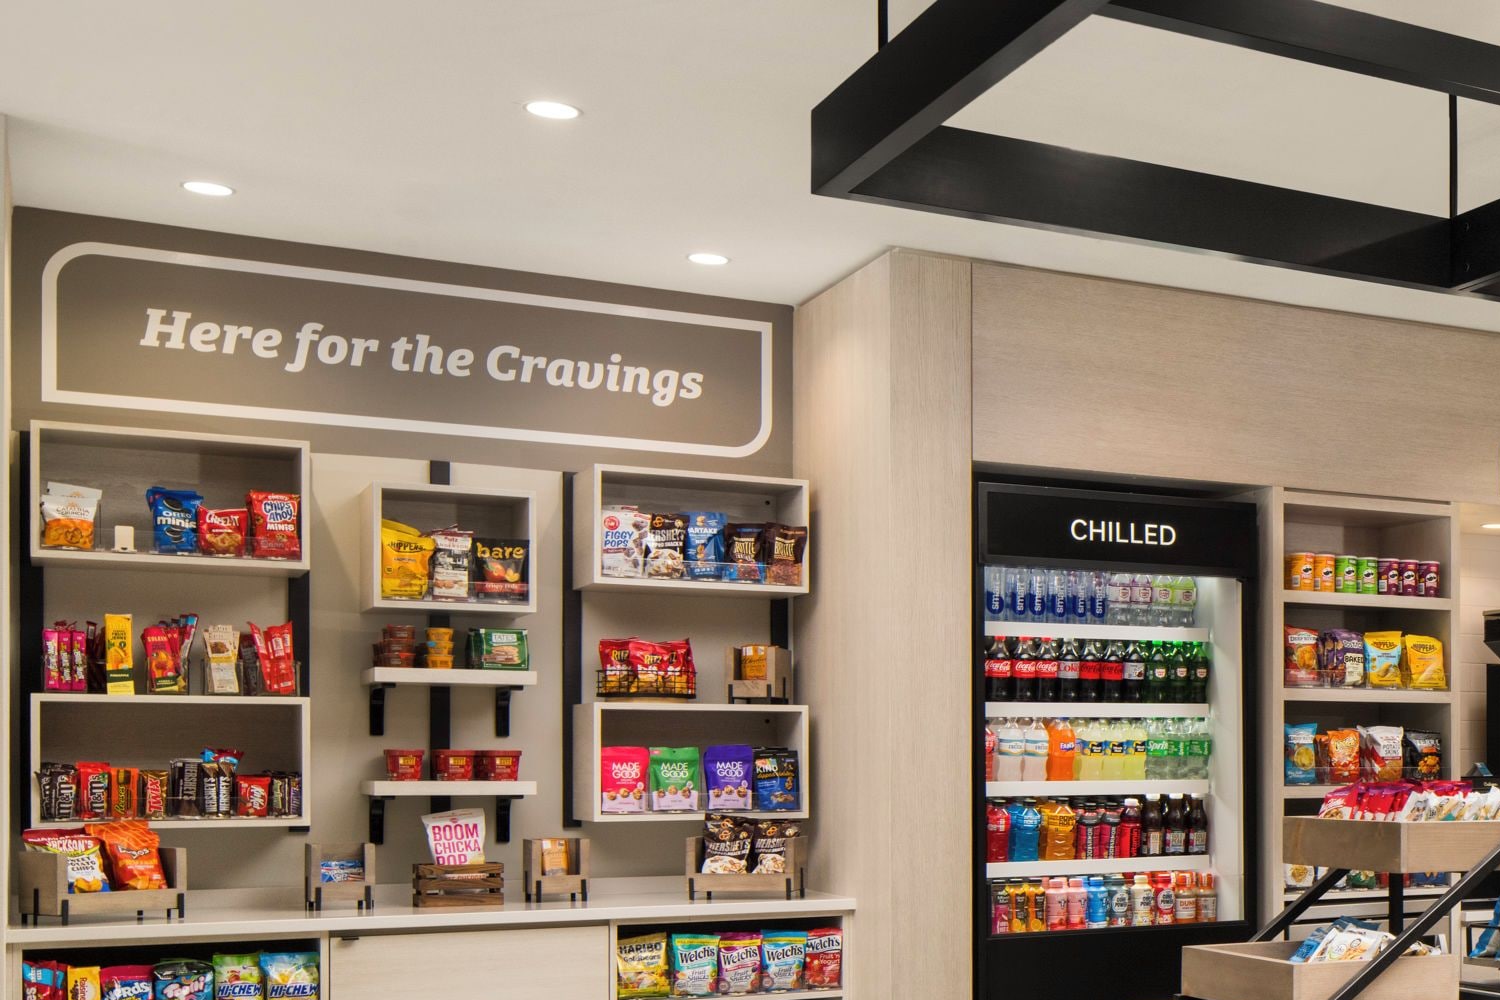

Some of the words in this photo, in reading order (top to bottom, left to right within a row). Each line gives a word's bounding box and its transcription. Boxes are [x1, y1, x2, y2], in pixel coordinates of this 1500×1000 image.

[141, 308, 282, 360] Here
[285, 322, 379, 373] for
[391, 333, 473, 379] the
[487, 343, 704, 408] Cravings
[157, 516, 197, 528] minis
[605, 531, 634, 540] FIGGY
[1070, 518, 1177, 546] CHILLED
[477, 542, 525, 559] bare
[604, 540, 629, 548] POPS
[1148, 740, 1168, 751] Sprit
[613, 762, 640, 771] MADE
[661, 762, 689, 770] MADE
[716, 761, 743, 769] MADE
[612, 770, 640, 779] GOOD
[662, 770, 689, 778] GOOD
[717, 769, 744, 777] GOOD
[432, 823, 479, 842] BOOM
[434, 839, 480, 855] CHICKA
[806, 936, 840, 951] Welch's
[680, 946, 716, 963] Welch's
[722, 947, 758, 965] Welch's
[766, 944, 803, 962] Welch's
[217, 983, 262, 997] HI-CHEW
[269, 983, 319, 998] HI-CHEW
